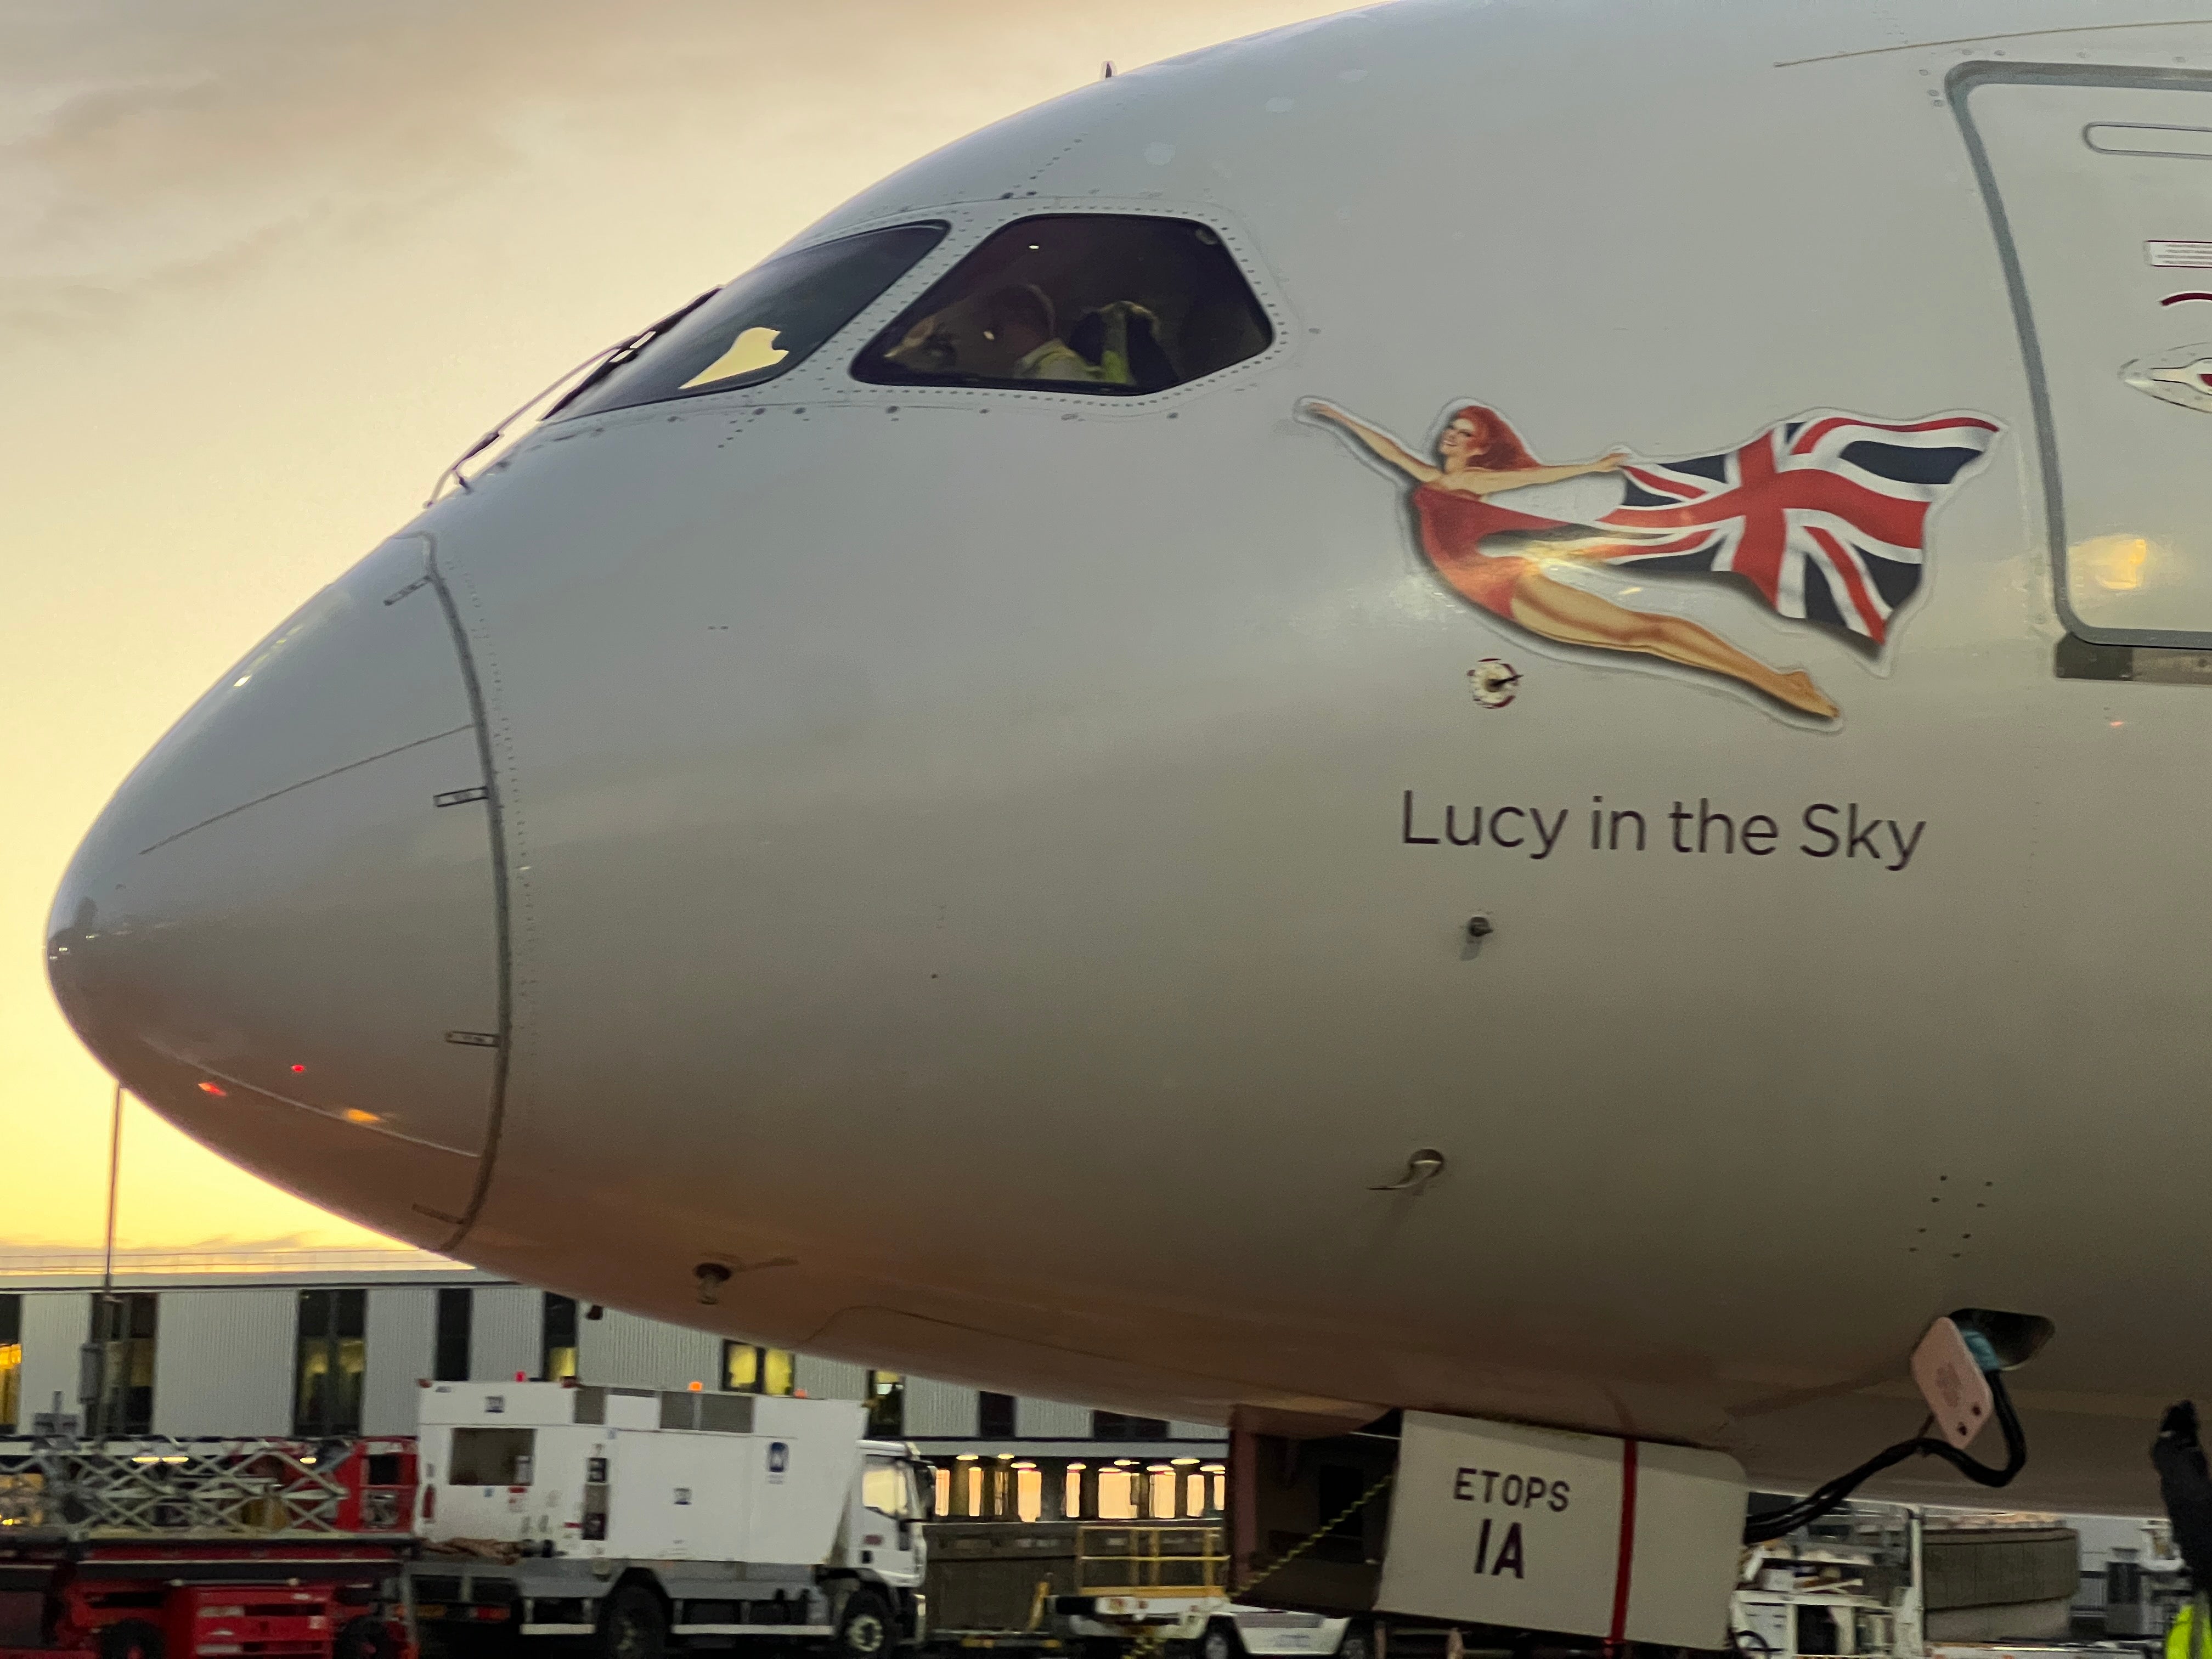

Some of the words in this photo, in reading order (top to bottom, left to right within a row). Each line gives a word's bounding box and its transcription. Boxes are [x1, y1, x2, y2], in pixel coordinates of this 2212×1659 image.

[1401, 789, 1569, 861] Lucy
[1590, 794, 1647, 851] in
[1667, 797, 1780, 856] the
[1799, 803, 1927, 872] Sky
[1452, 1466, 1571, 1513] ETOPS
